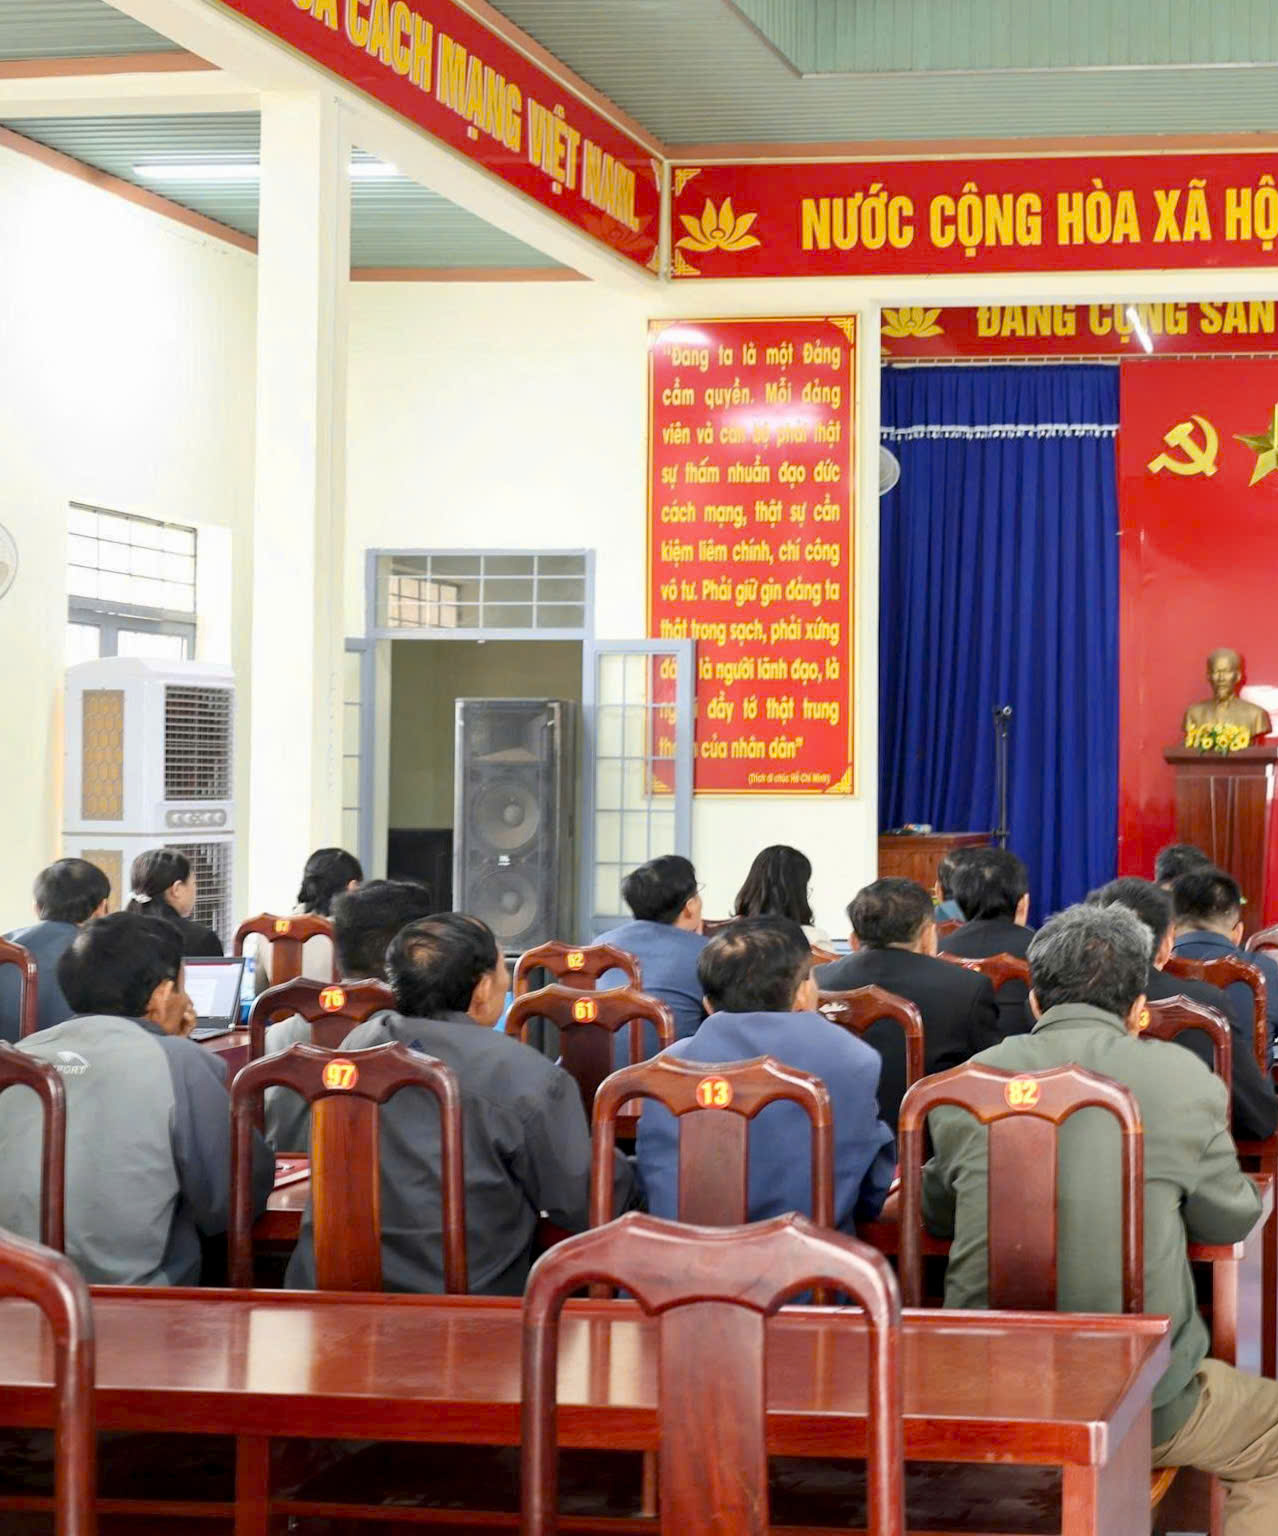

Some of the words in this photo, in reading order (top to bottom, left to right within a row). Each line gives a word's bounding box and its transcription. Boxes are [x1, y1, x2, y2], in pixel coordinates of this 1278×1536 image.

[437, 33, 522, 153] MẠNG
[528, 97, 580, 194] VIỆT
[802, 183, 913, 250] NƯỚC
[930, 181, 1041, 258] CỘNG
[1058, 178, 1141, 245] HÒA
[1153, 179, 1212, 242] XÃ
[575, 1001, 594, 1020] 61
[326, 1063, 355, 1088] 97
[701, 1081, 728, 1105] 13
